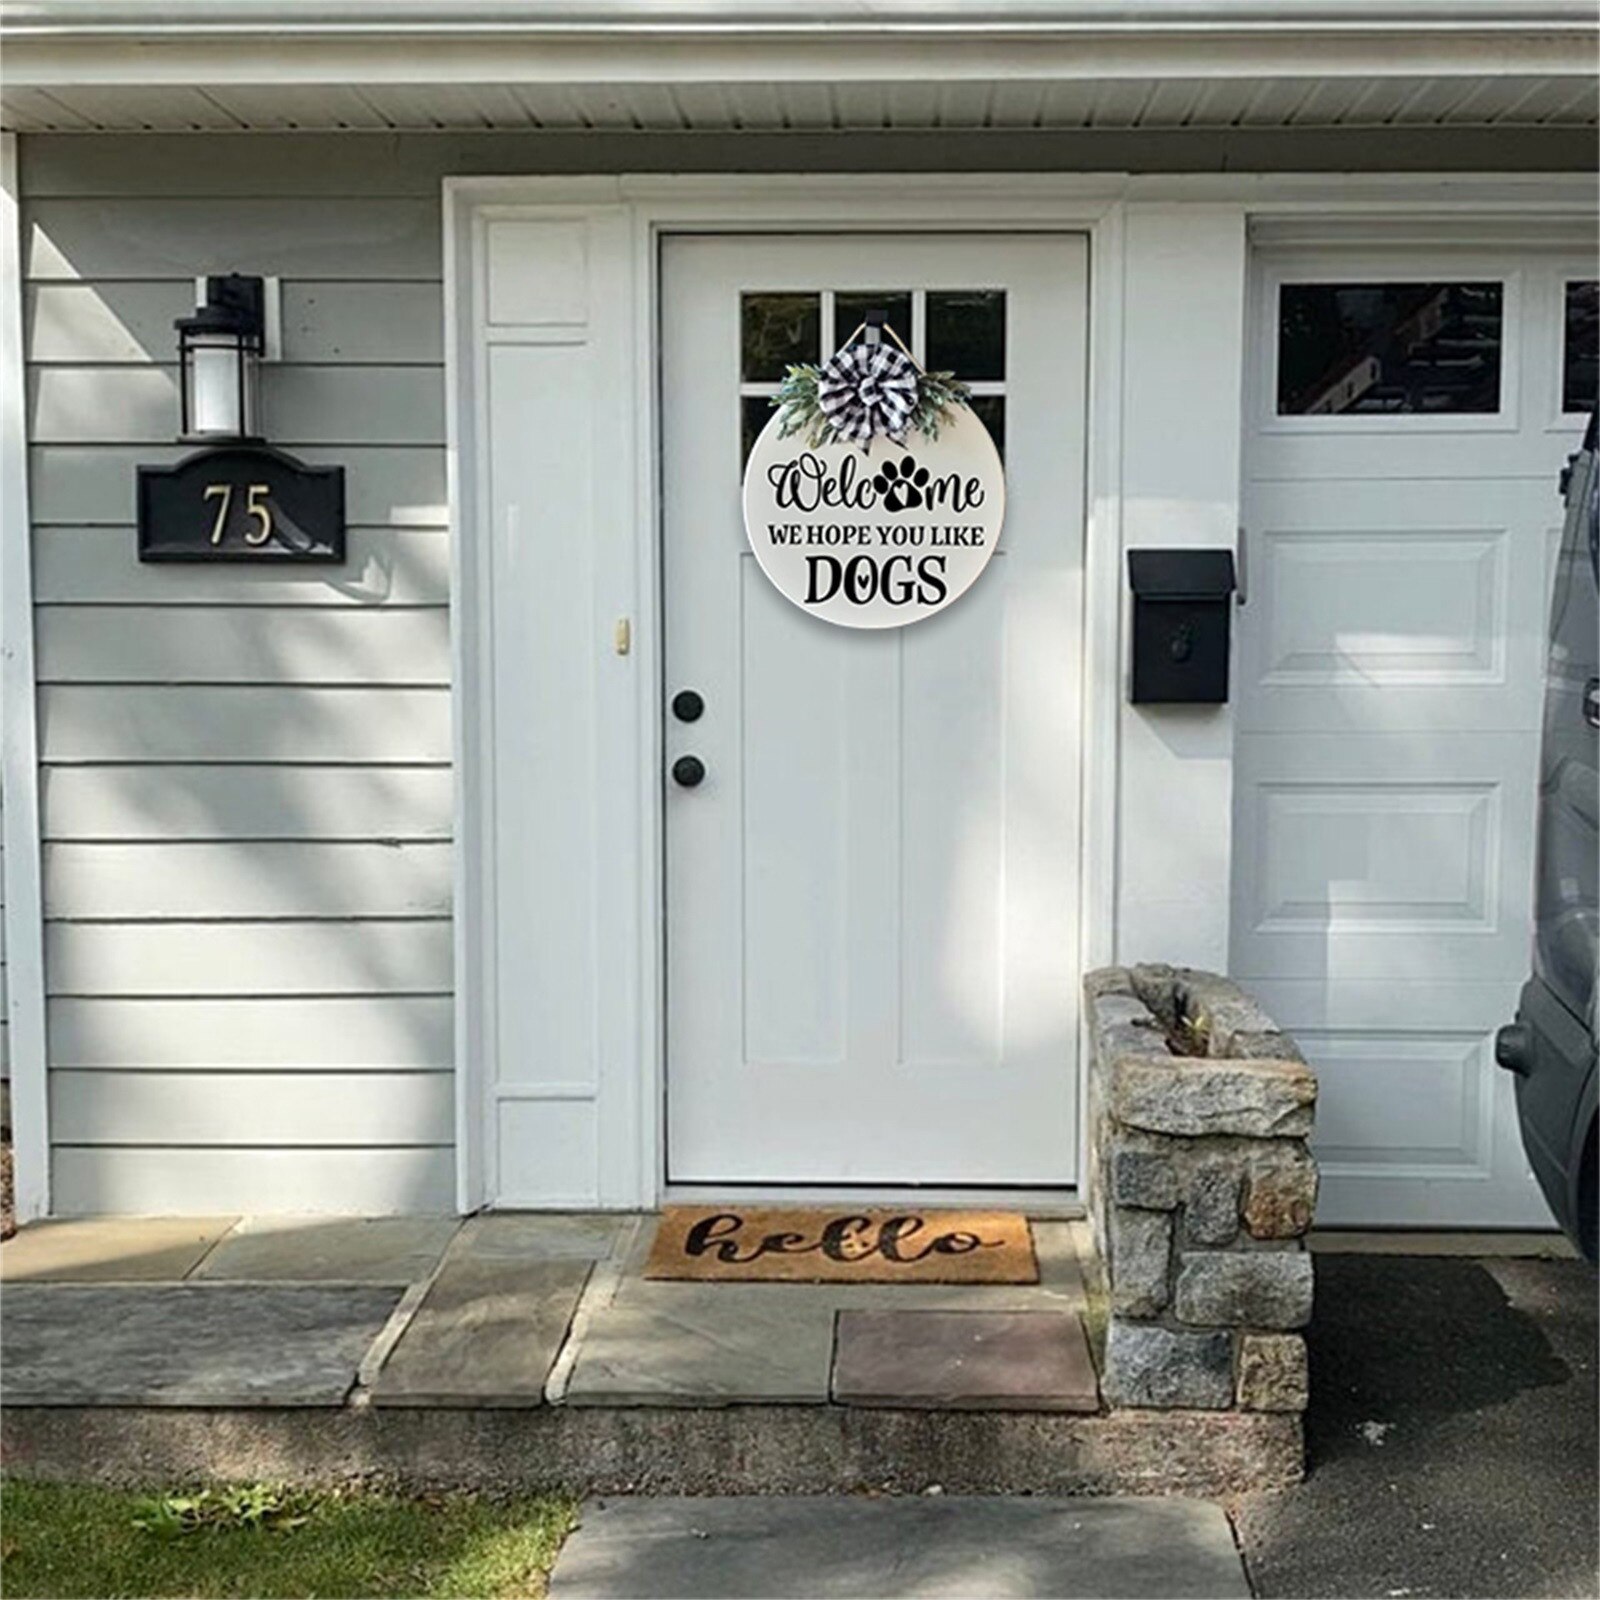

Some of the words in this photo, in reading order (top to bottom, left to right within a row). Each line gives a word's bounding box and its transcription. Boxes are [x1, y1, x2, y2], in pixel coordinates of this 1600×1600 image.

[203, 484, 272, 544] 75
[767, 524, 802, 545] WE
[806, 524, 871, 546] HOPE
[876, 524, 925, 546] YOU
[930, 525, 985, 546] LIKE
[804, 554, 948, 605] DOGS
[685, 1213, 1005, 1264] hello
